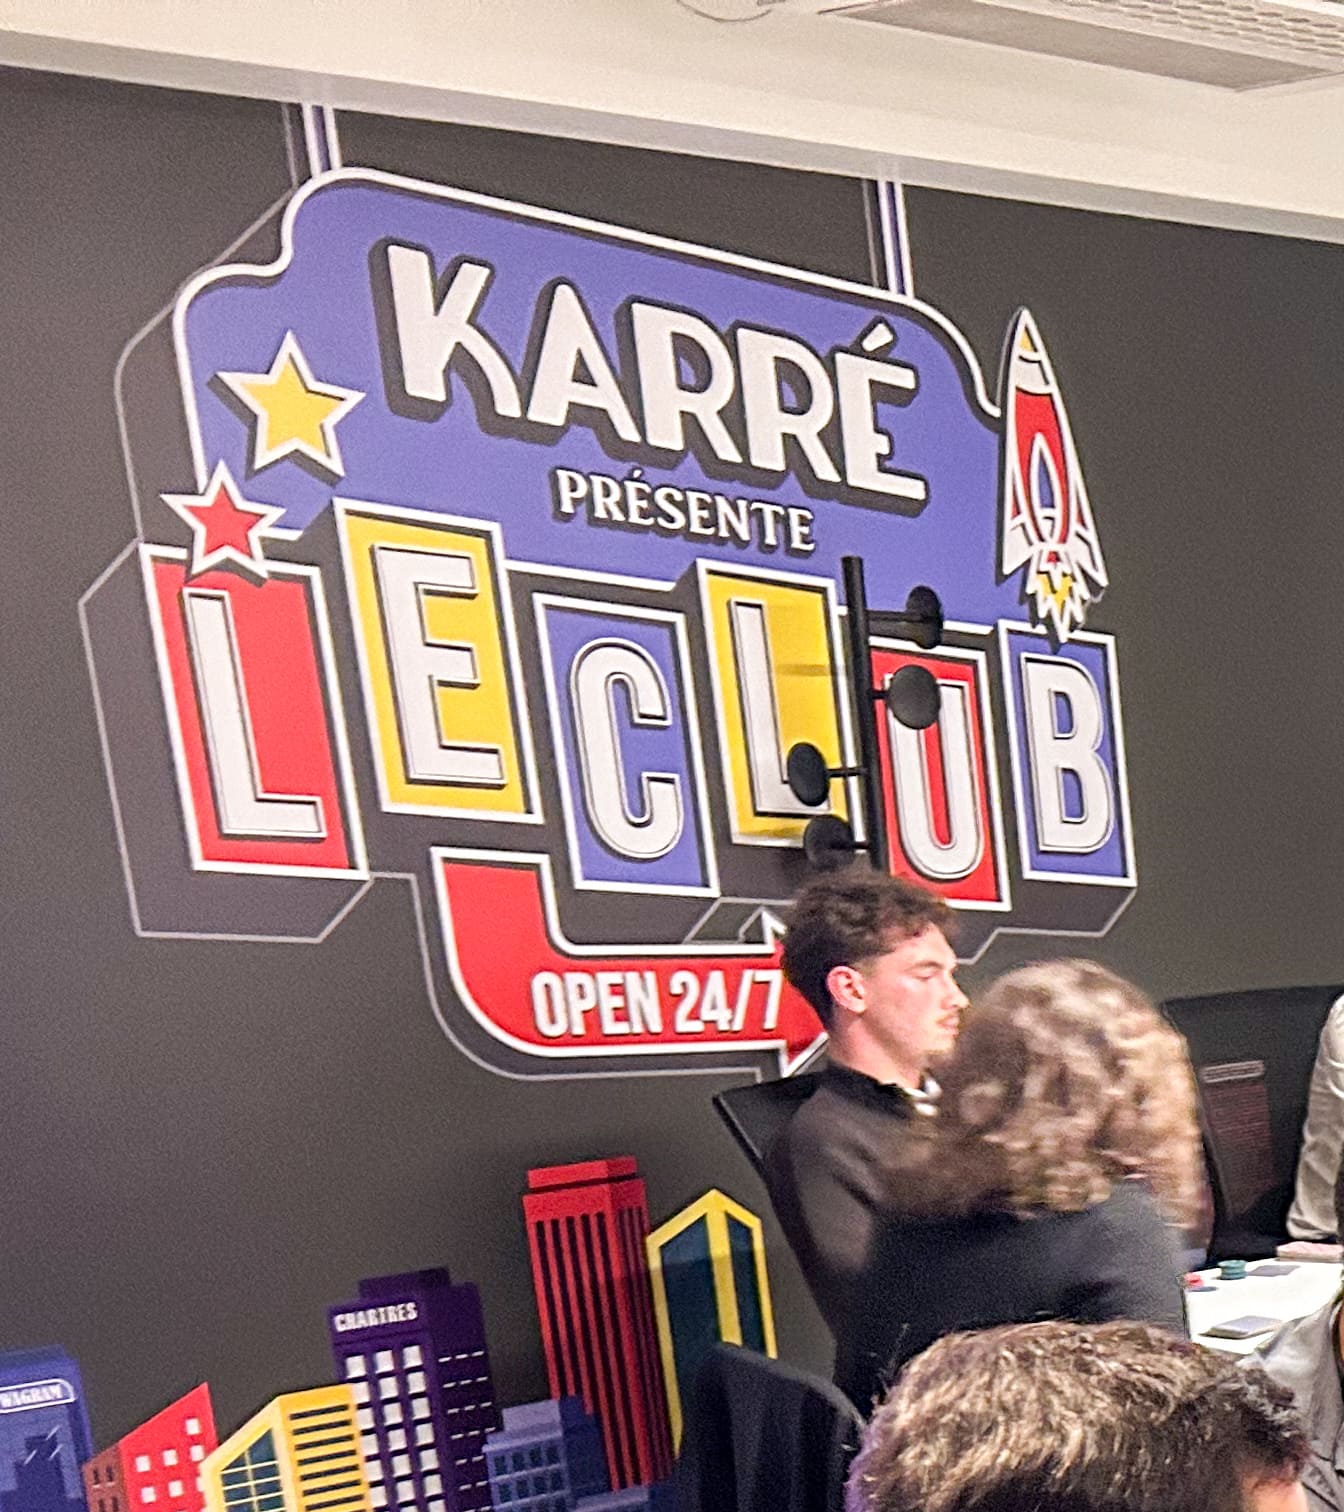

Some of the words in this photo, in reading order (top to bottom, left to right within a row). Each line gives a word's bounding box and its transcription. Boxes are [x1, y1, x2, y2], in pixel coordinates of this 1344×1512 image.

[385, 243, 928, 503] KARRÉ
[555, 468, 818, 552] PRÉSENTE
[531, 970, 663, 1037] OPEN
[669, 969, 783, 1033] 24/7
[334, 1302, 418, 1332] CHARTRES
